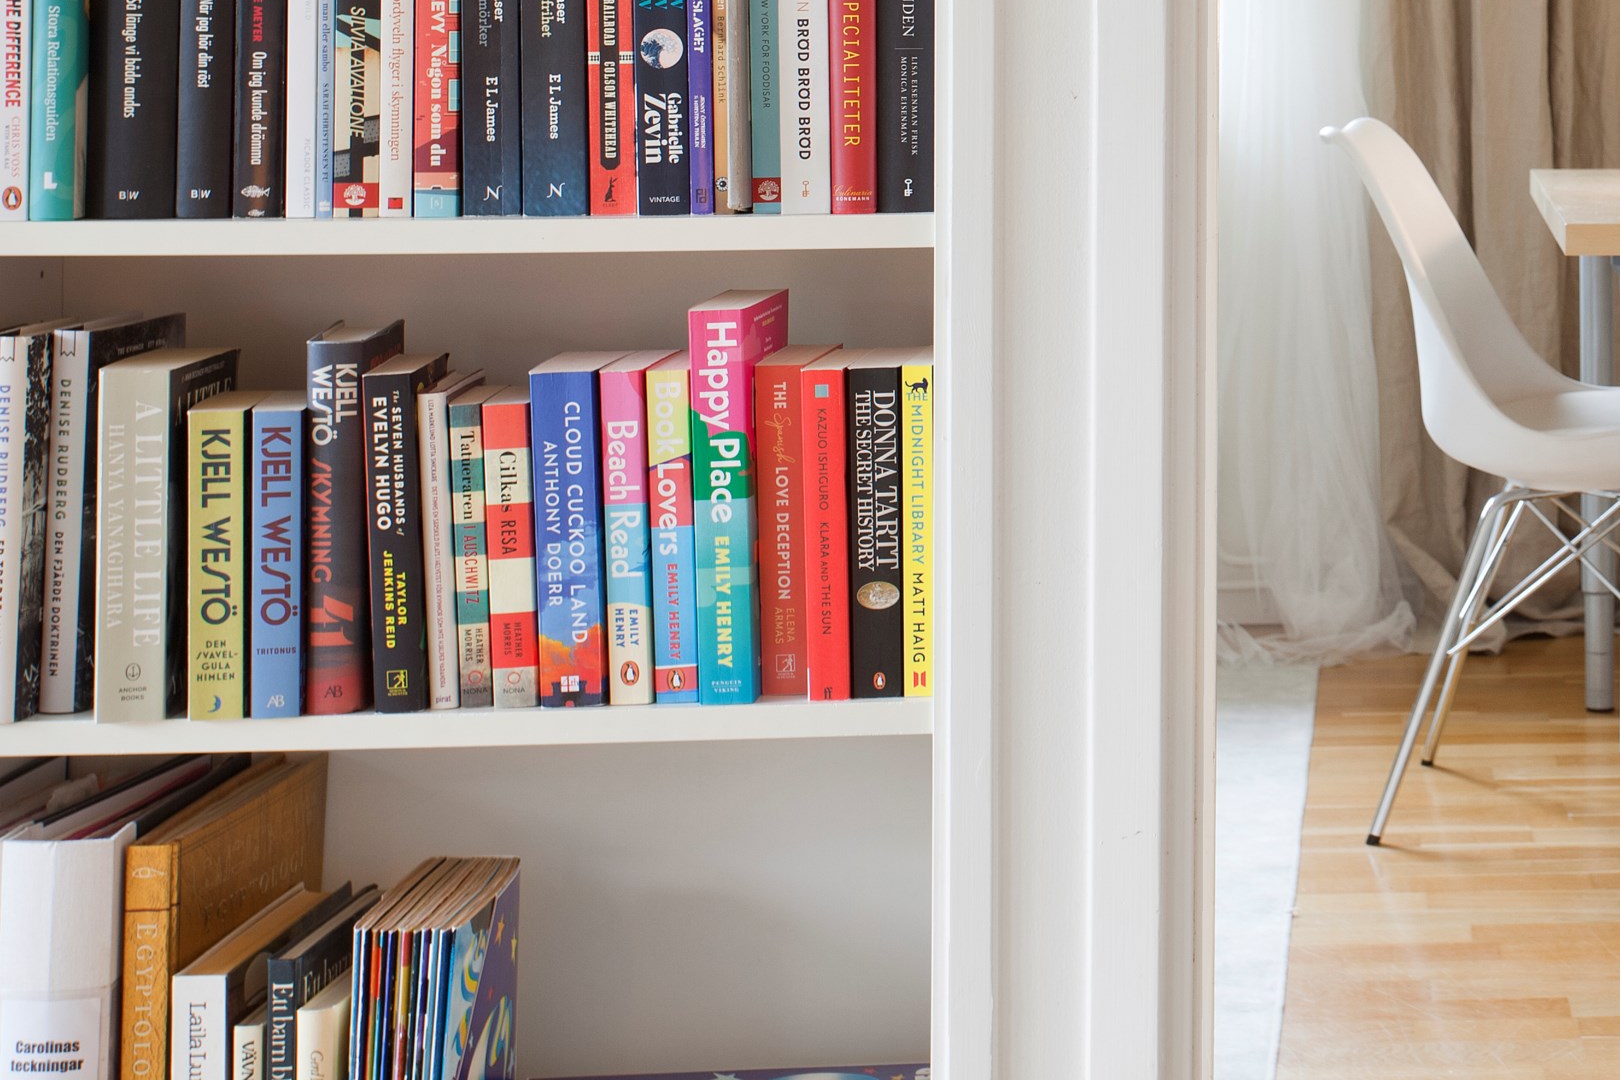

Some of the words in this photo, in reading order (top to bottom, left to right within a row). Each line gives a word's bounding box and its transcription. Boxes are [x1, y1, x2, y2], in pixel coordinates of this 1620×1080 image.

[46, 6, 61, 41] Stora
[350, 6, 367, 42] SILVIA
[5, 19, 22, 108] DIFFERENCE
[44, 42, 61, 141] Relationsguiden
[350, 45, 366, 138] AVALLONE
[603, 61, 617, 99] COLSON
[604, 99, 617, 159] WHITEHEAD
[644, 92, 668, 165] Zevin
[667, 92, 684, 164] Gabrielle
[59, 378, 72, 440] DENISE
[698, 322, 738, 431] Happy
[855, 391, 871, 427] THE
[372, 397, 390, 472] EVELYN
[563, 401, 583, 474] CLOUD
[654, 382, 685, 455] Book
[872, 389, 897, 482] DONNA
[56, 445, 70, 521] RUDBERG
[133, 433, 163, 558] LITTLE
[261, 426, 291, 507] KJELL
[543, 441, 562, 535] ANTHONY
[607, 421, 640, 501] Beach
[710, 438, 741, 524] Place
[855, 429, 872, 493] SECRET
[376, 474, 392, 531] HUGO
[566, 483, 585, 574] CUCKOO
[657, 462, 685, 557] Lovers
[857, 494, 874, 572] HISTORY
[875, 487, 899, 571] TARTT
[54, 531, 64, 556] DEN
[260, 515, 298, 626] WESTÖ
[546, 543, 563, 607] DOERR
[609, 509, 643, 578] Read
[52, 557, 65, 603] FJÄRDE
[133, 570, 162, 648] LIFE
[396, 572, 408, 626] TAYLOR
[569, 584, 588, 644] LAND
[912, 573, 926, 616] MATT
[49, 605, 61, 677] DOKTRINEN
[201, 662, 230, 671] GULA
[256, 647, 297, 656] TRITONUS
[912, 622, 926, 664] HAIG
[10, 1058, 84, 1074] teckningar
[15, 1040, 80, 1054] Carolinas
